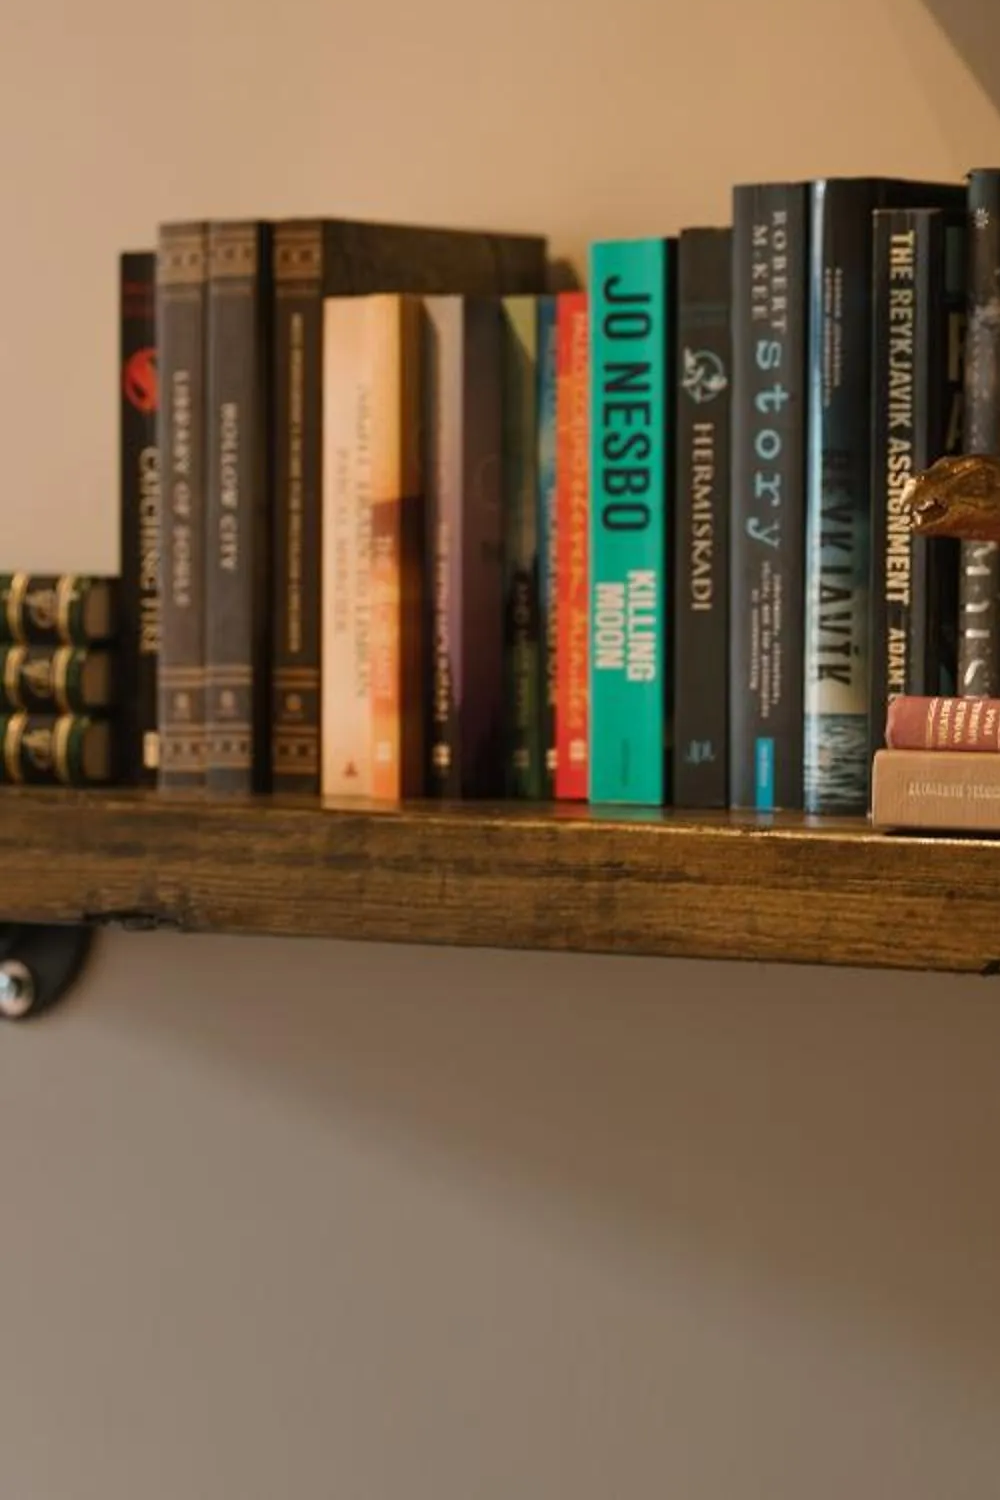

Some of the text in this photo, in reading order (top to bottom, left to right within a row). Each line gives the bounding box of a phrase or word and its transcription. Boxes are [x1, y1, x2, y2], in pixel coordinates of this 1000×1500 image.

[601, 275, 653, 531] JO NESBO
[746, 340, 790, 549] story
[887, 231, 915, 604] THE REYKJAVIK ASSIGNMENT
[219, 513, 239, 570] CITY
[594, 582, 625, 669] MOON
[626, 569, 657, 682] KILLING
[888, 627, 906, 684] ADAM
